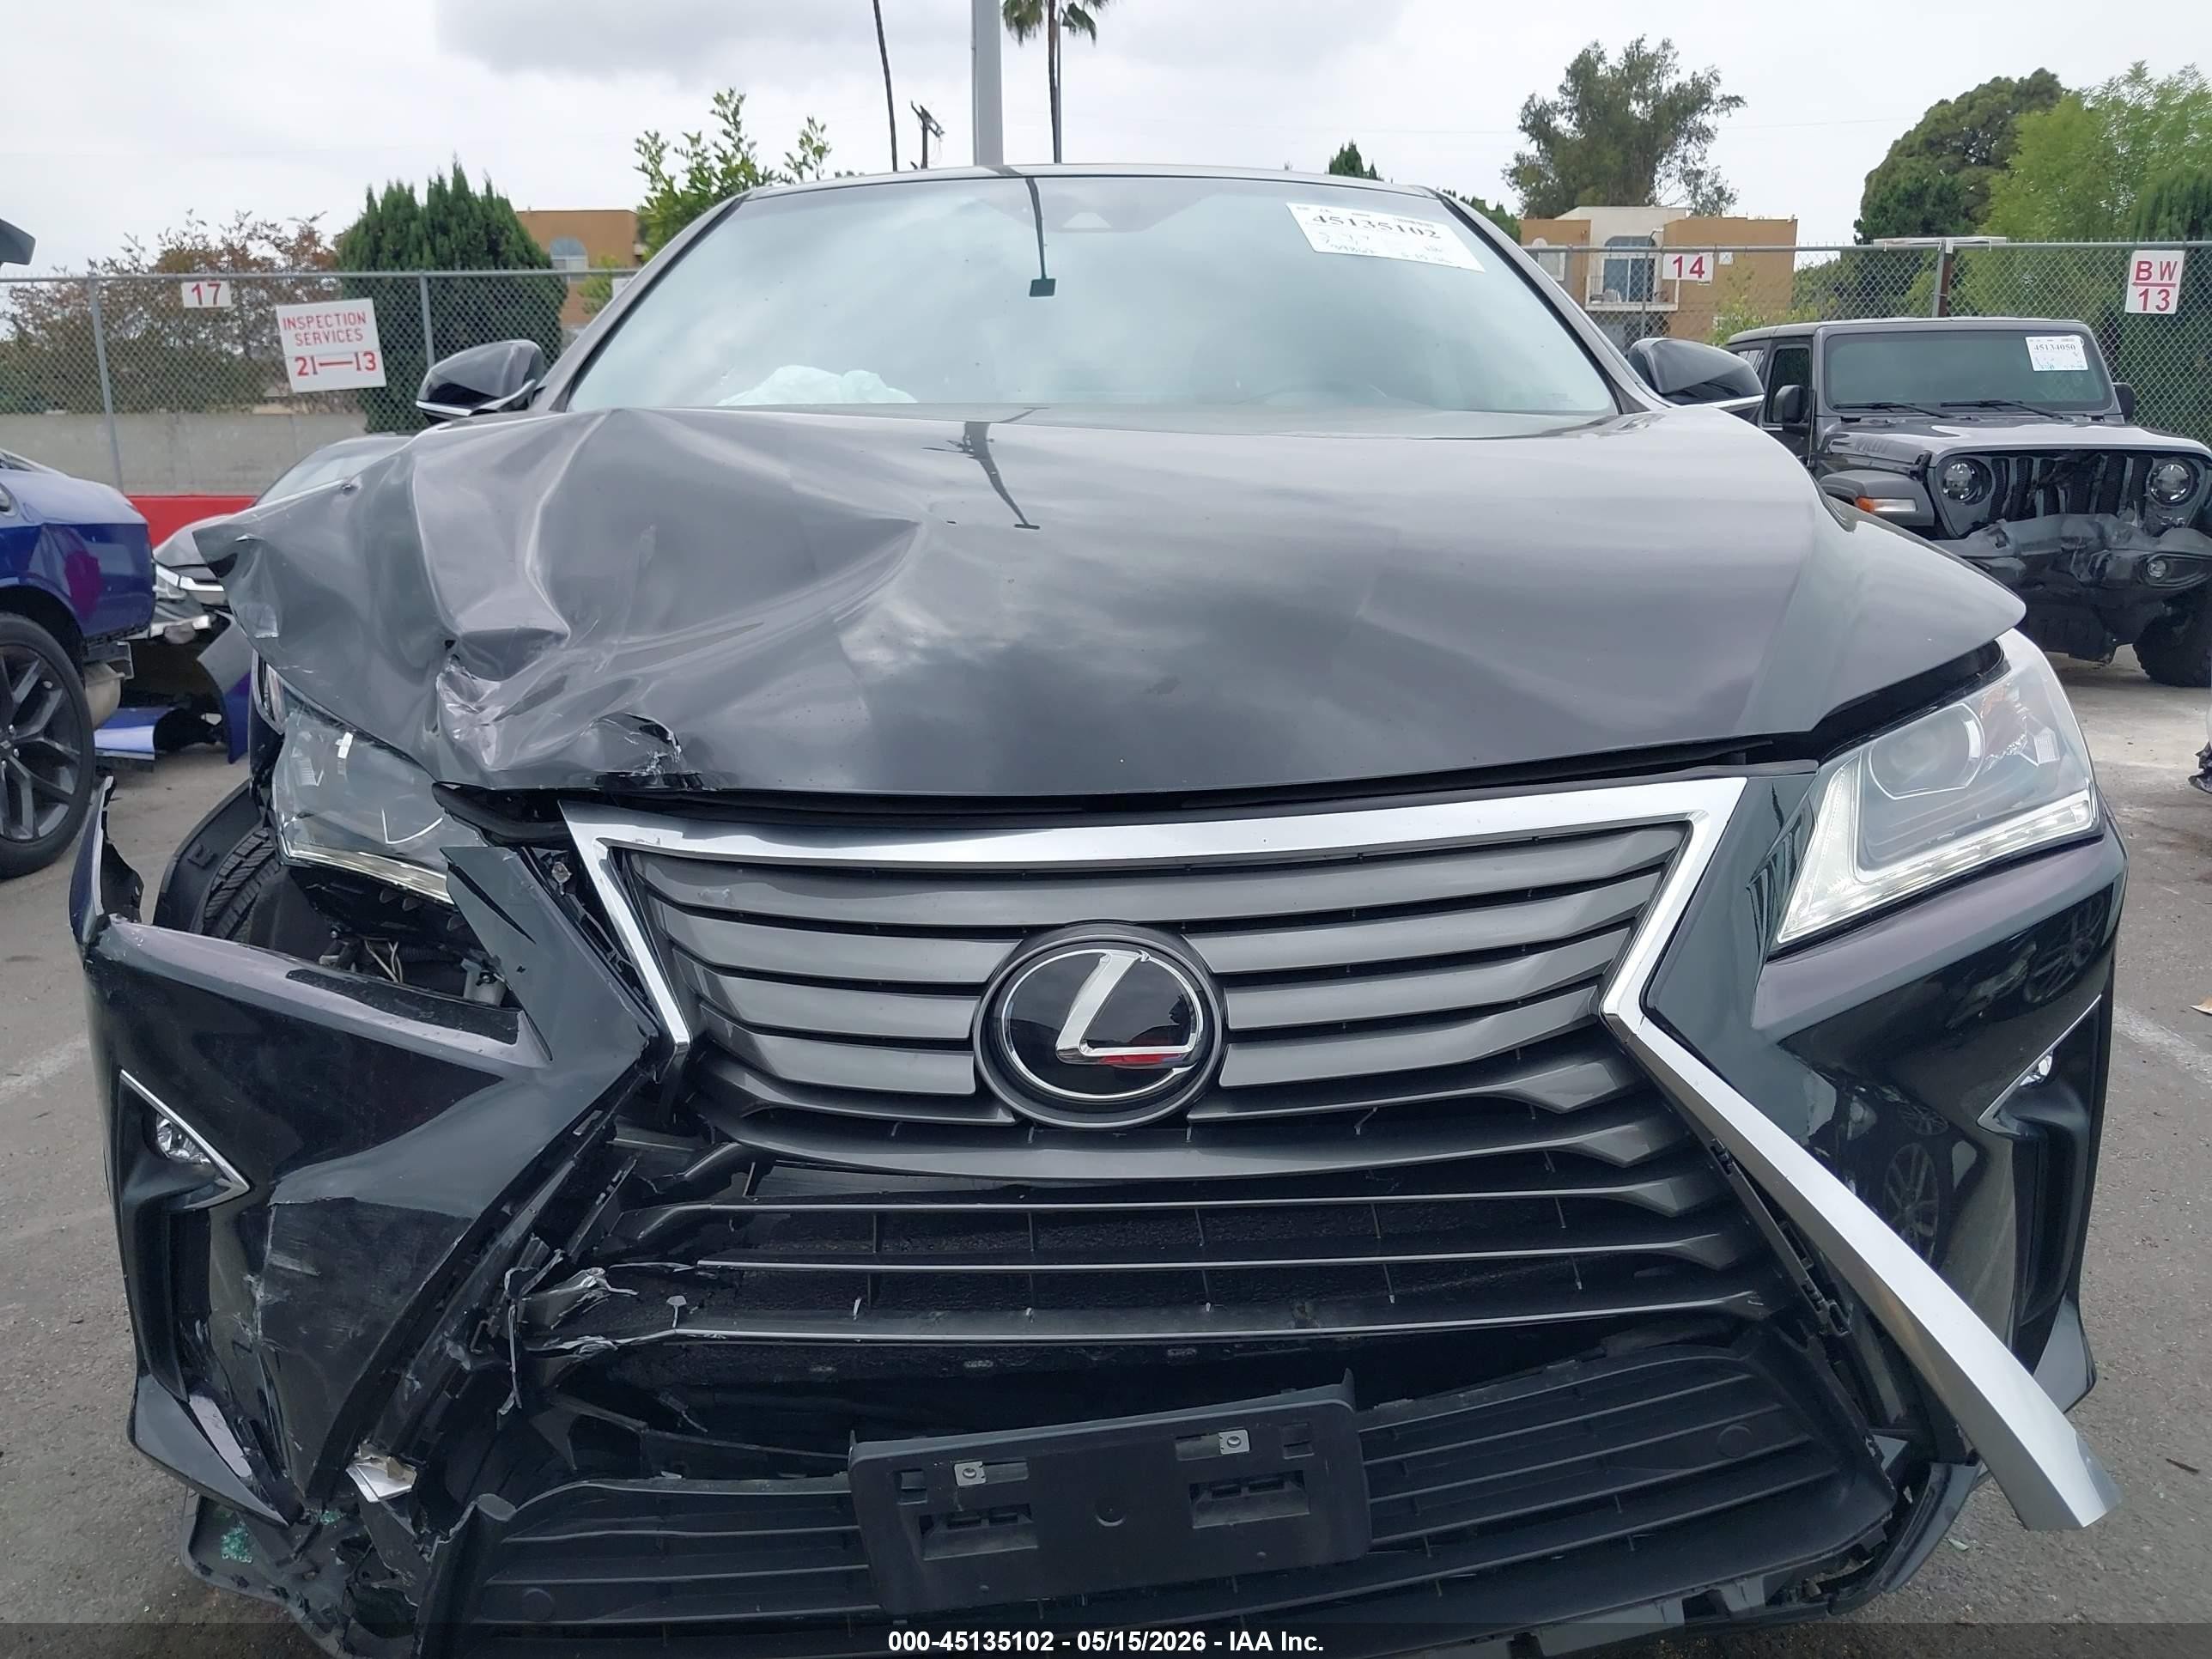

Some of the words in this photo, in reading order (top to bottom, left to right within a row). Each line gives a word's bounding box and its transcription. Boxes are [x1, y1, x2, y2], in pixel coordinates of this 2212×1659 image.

[1312, 214, 1442, 240] 45135102
[1673, 256, 1705, 278] 14
[191, 283, 222, 306] 17
[2138, 288, 2170, 312] 13
[283, 311, 367, 330] INSPECTION
[294, 328, 364, 347] SERVICES
